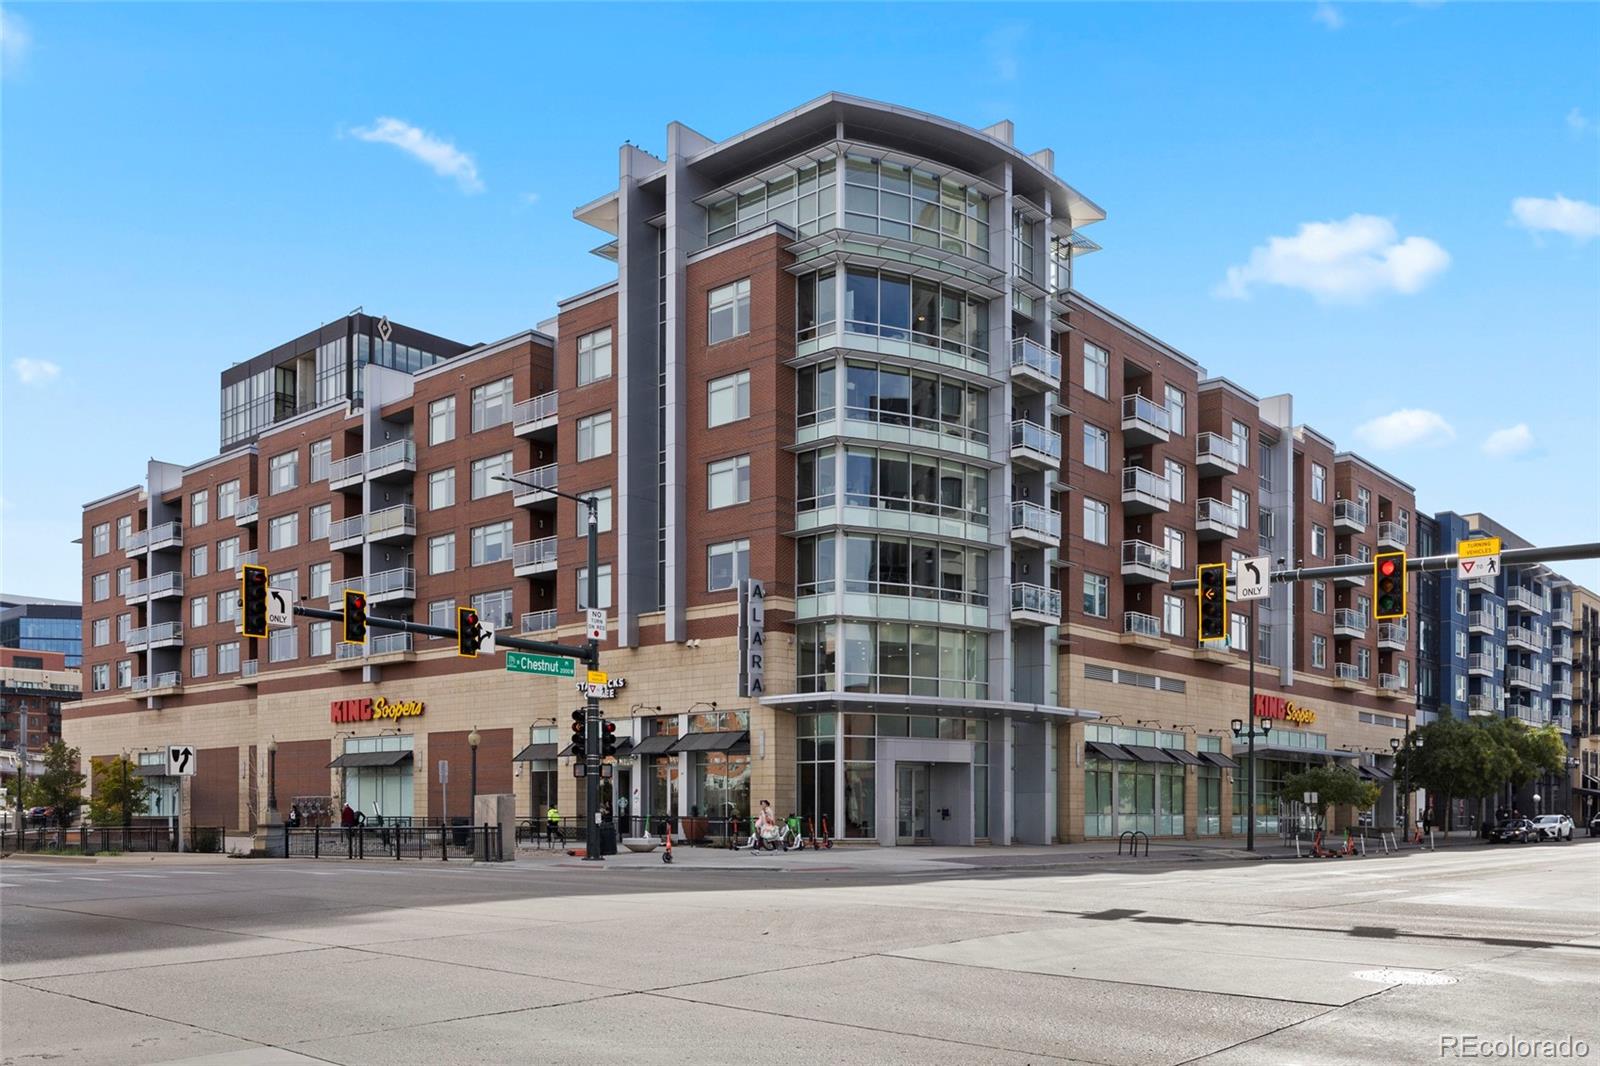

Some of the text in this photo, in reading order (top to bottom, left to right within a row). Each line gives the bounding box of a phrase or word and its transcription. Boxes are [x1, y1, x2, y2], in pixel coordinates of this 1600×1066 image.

[1242, 587, 1263, 596] ONLY
[270, 614, 287, 623] ONLY
[752, 584, 763, 692] ALARA
[520, 656, 559, 673] Chestnut
[331, 696, 423, 722] KING Soopers
[1254, 694, 1286, 720] KING
